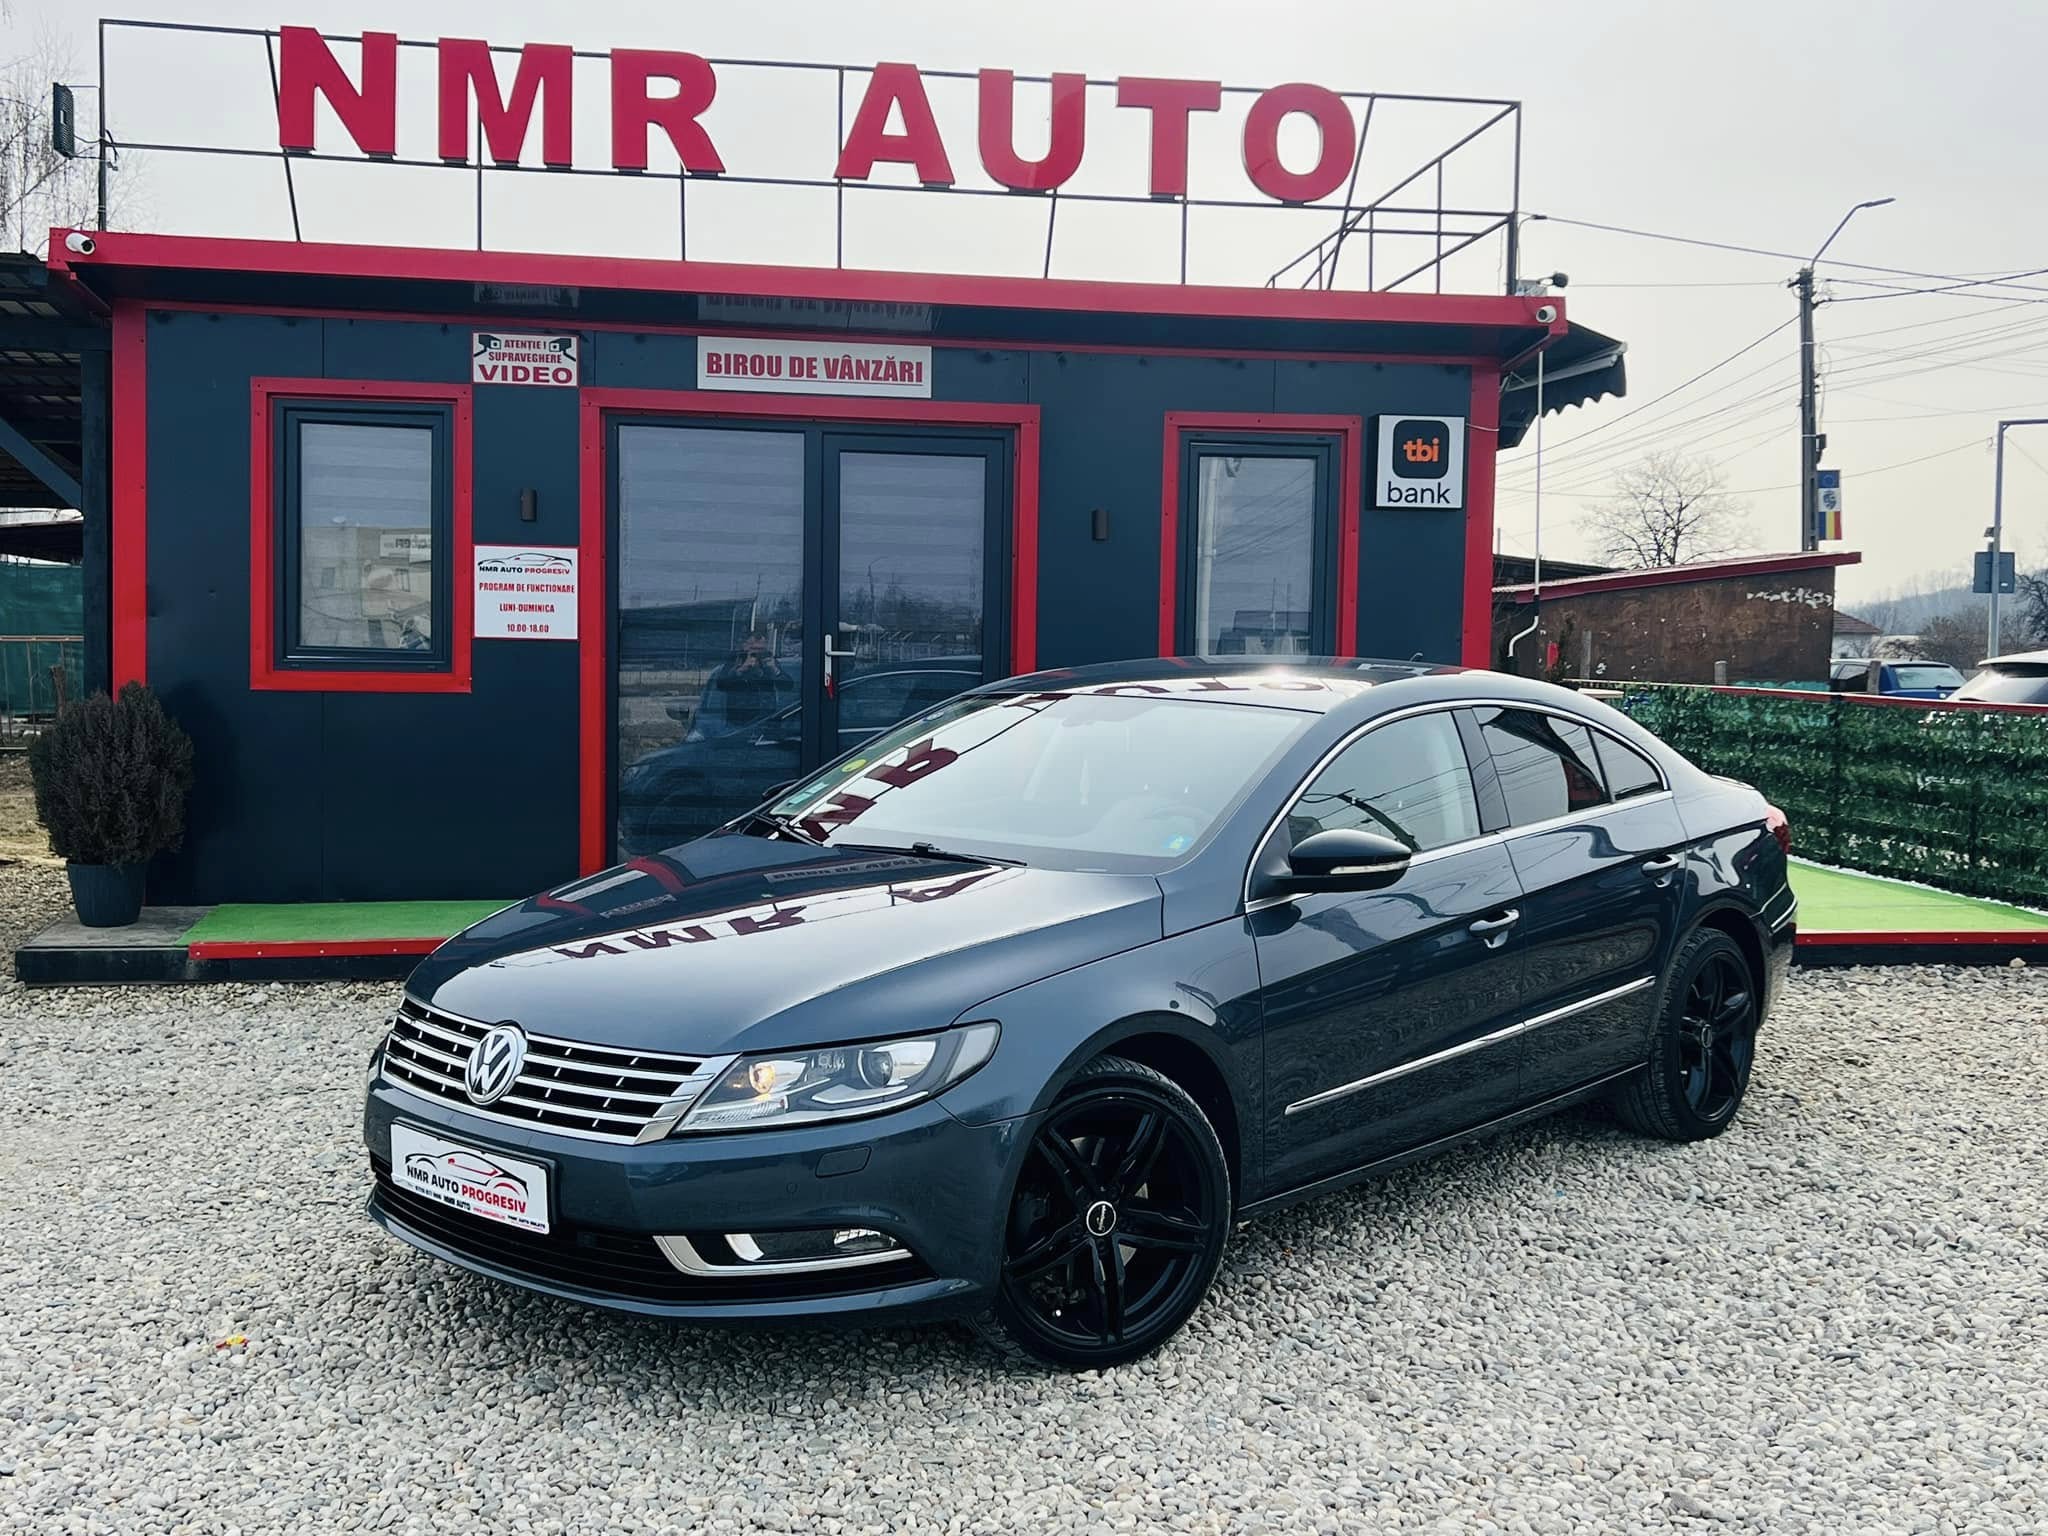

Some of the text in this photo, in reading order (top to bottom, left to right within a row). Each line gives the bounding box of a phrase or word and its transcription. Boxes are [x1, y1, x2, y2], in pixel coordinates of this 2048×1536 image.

[279, 25, 1357, 204] NMR AUTO
[488, 352, 562, 364] SUPRAVEGHERE
[706, 352, 923, 383] BIROU DE VÂNZĂRI
[478, 364, 573, 384] VIDEO
[1403, 437, 1440, 462] tbi
[1387, 481, 1451, 504] bank
[524, 567, 570, 575] PROGRESIV
[479, 582, 515, 592] PROGRAM
[516, 583, 525, 592] DE
[406, 1164, 429, 1184] NMR
[431, 1174, 459, 1194] AUTO
[461, 1184, 526, 1214] PROGRESIV
